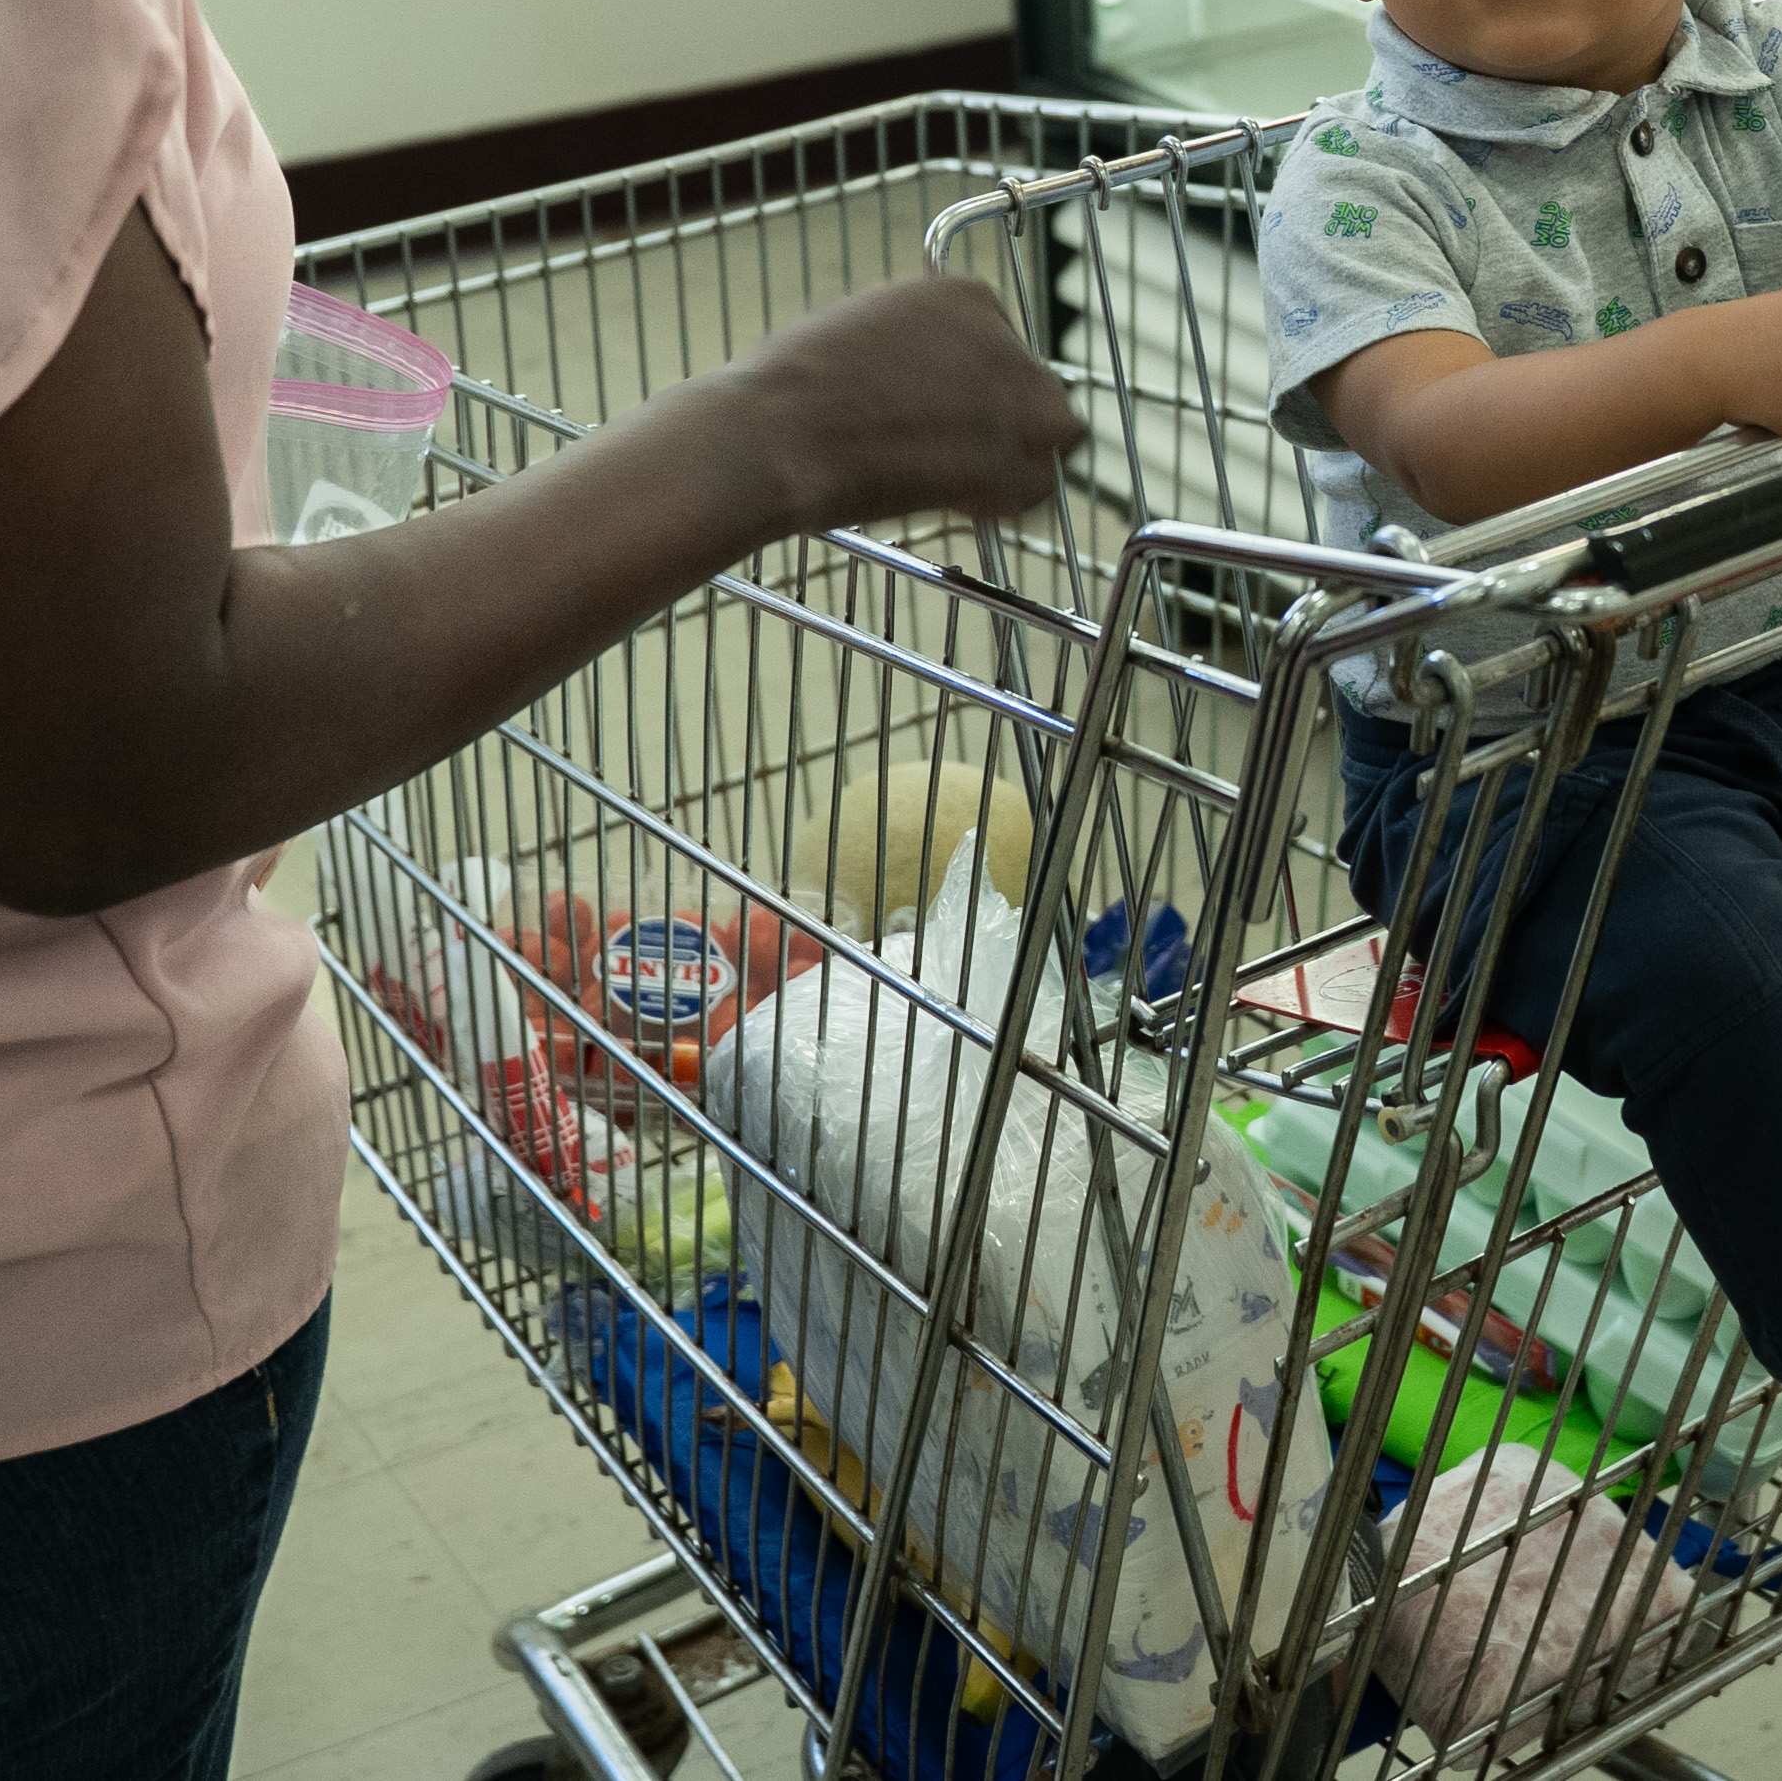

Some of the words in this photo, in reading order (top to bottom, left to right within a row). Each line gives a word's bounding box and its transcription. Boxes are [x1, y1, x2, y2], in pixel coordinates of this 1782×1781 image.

[1732, 95, 1752, 131] WIL
[1332, 201, 1378, 223] ONE
[1530, 200, 1561, 247] WILD
[1548, 207, 1573, 248] ONE
[1324, 219, 1372, 239] WILD
[1595, 307, 1622, 338] ON
